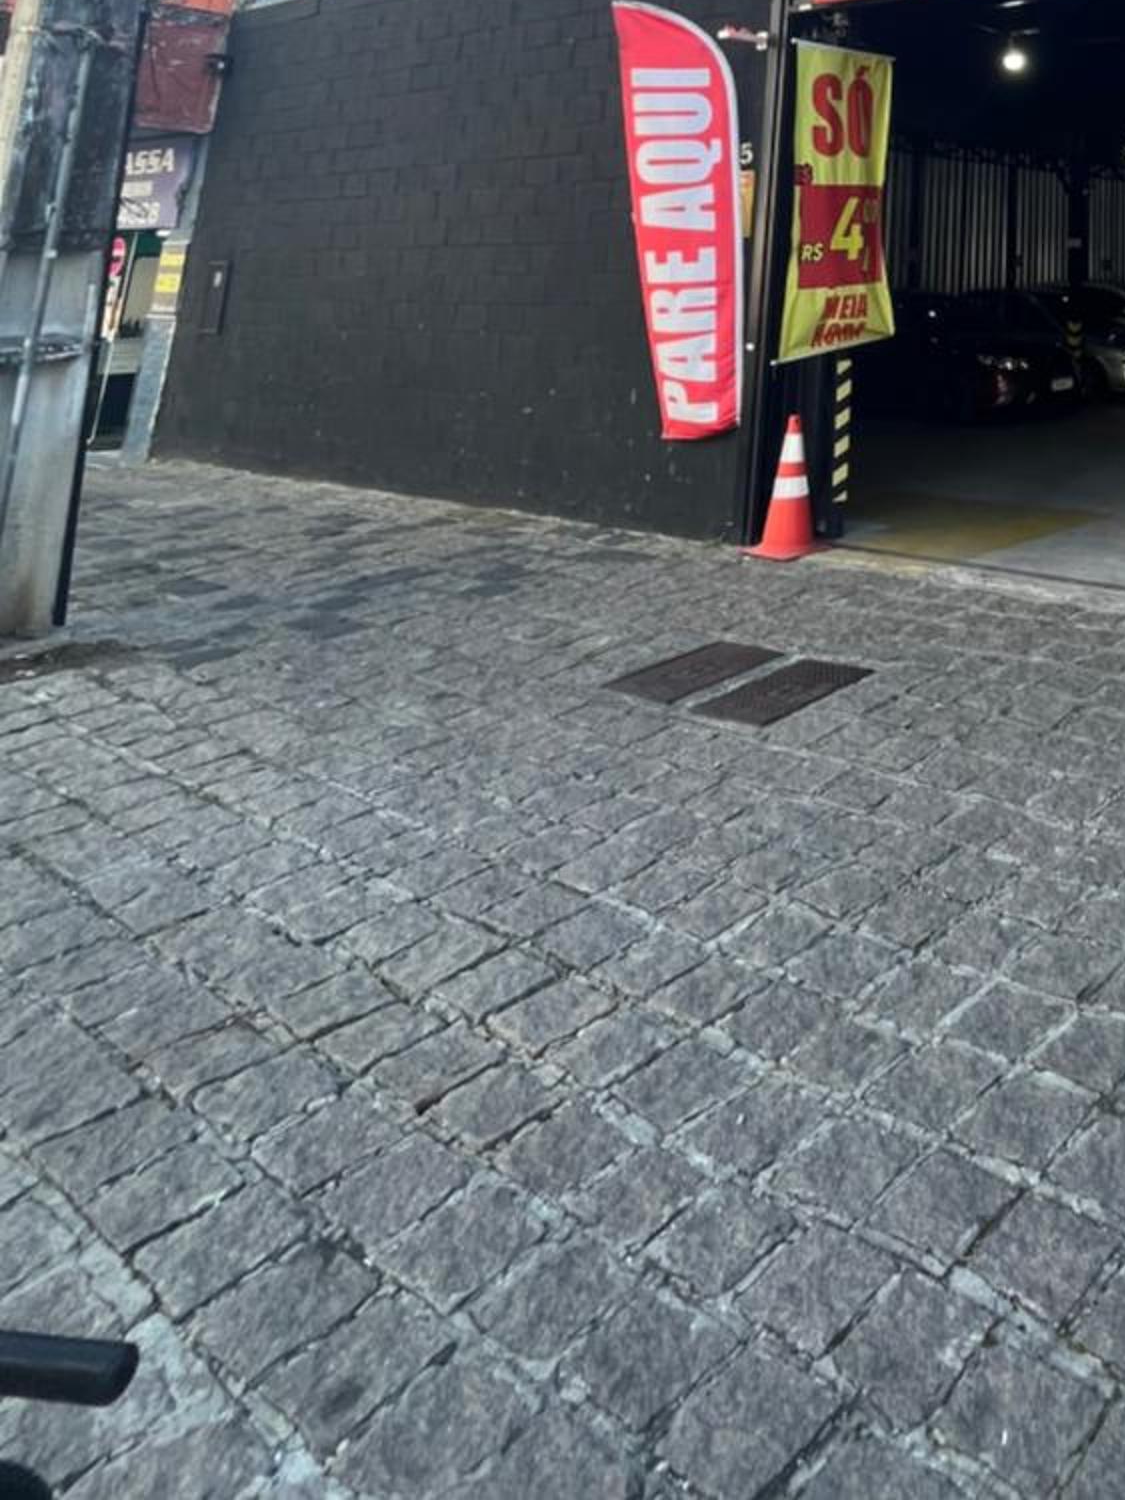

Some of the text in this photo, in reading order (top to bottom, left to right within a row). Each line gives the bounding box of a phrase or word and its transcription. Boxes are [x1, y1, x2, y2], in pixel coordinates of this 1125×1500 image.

[811, 63, 874, 158] SÓ
[631, 68, 721, 424] PARE AQUI
